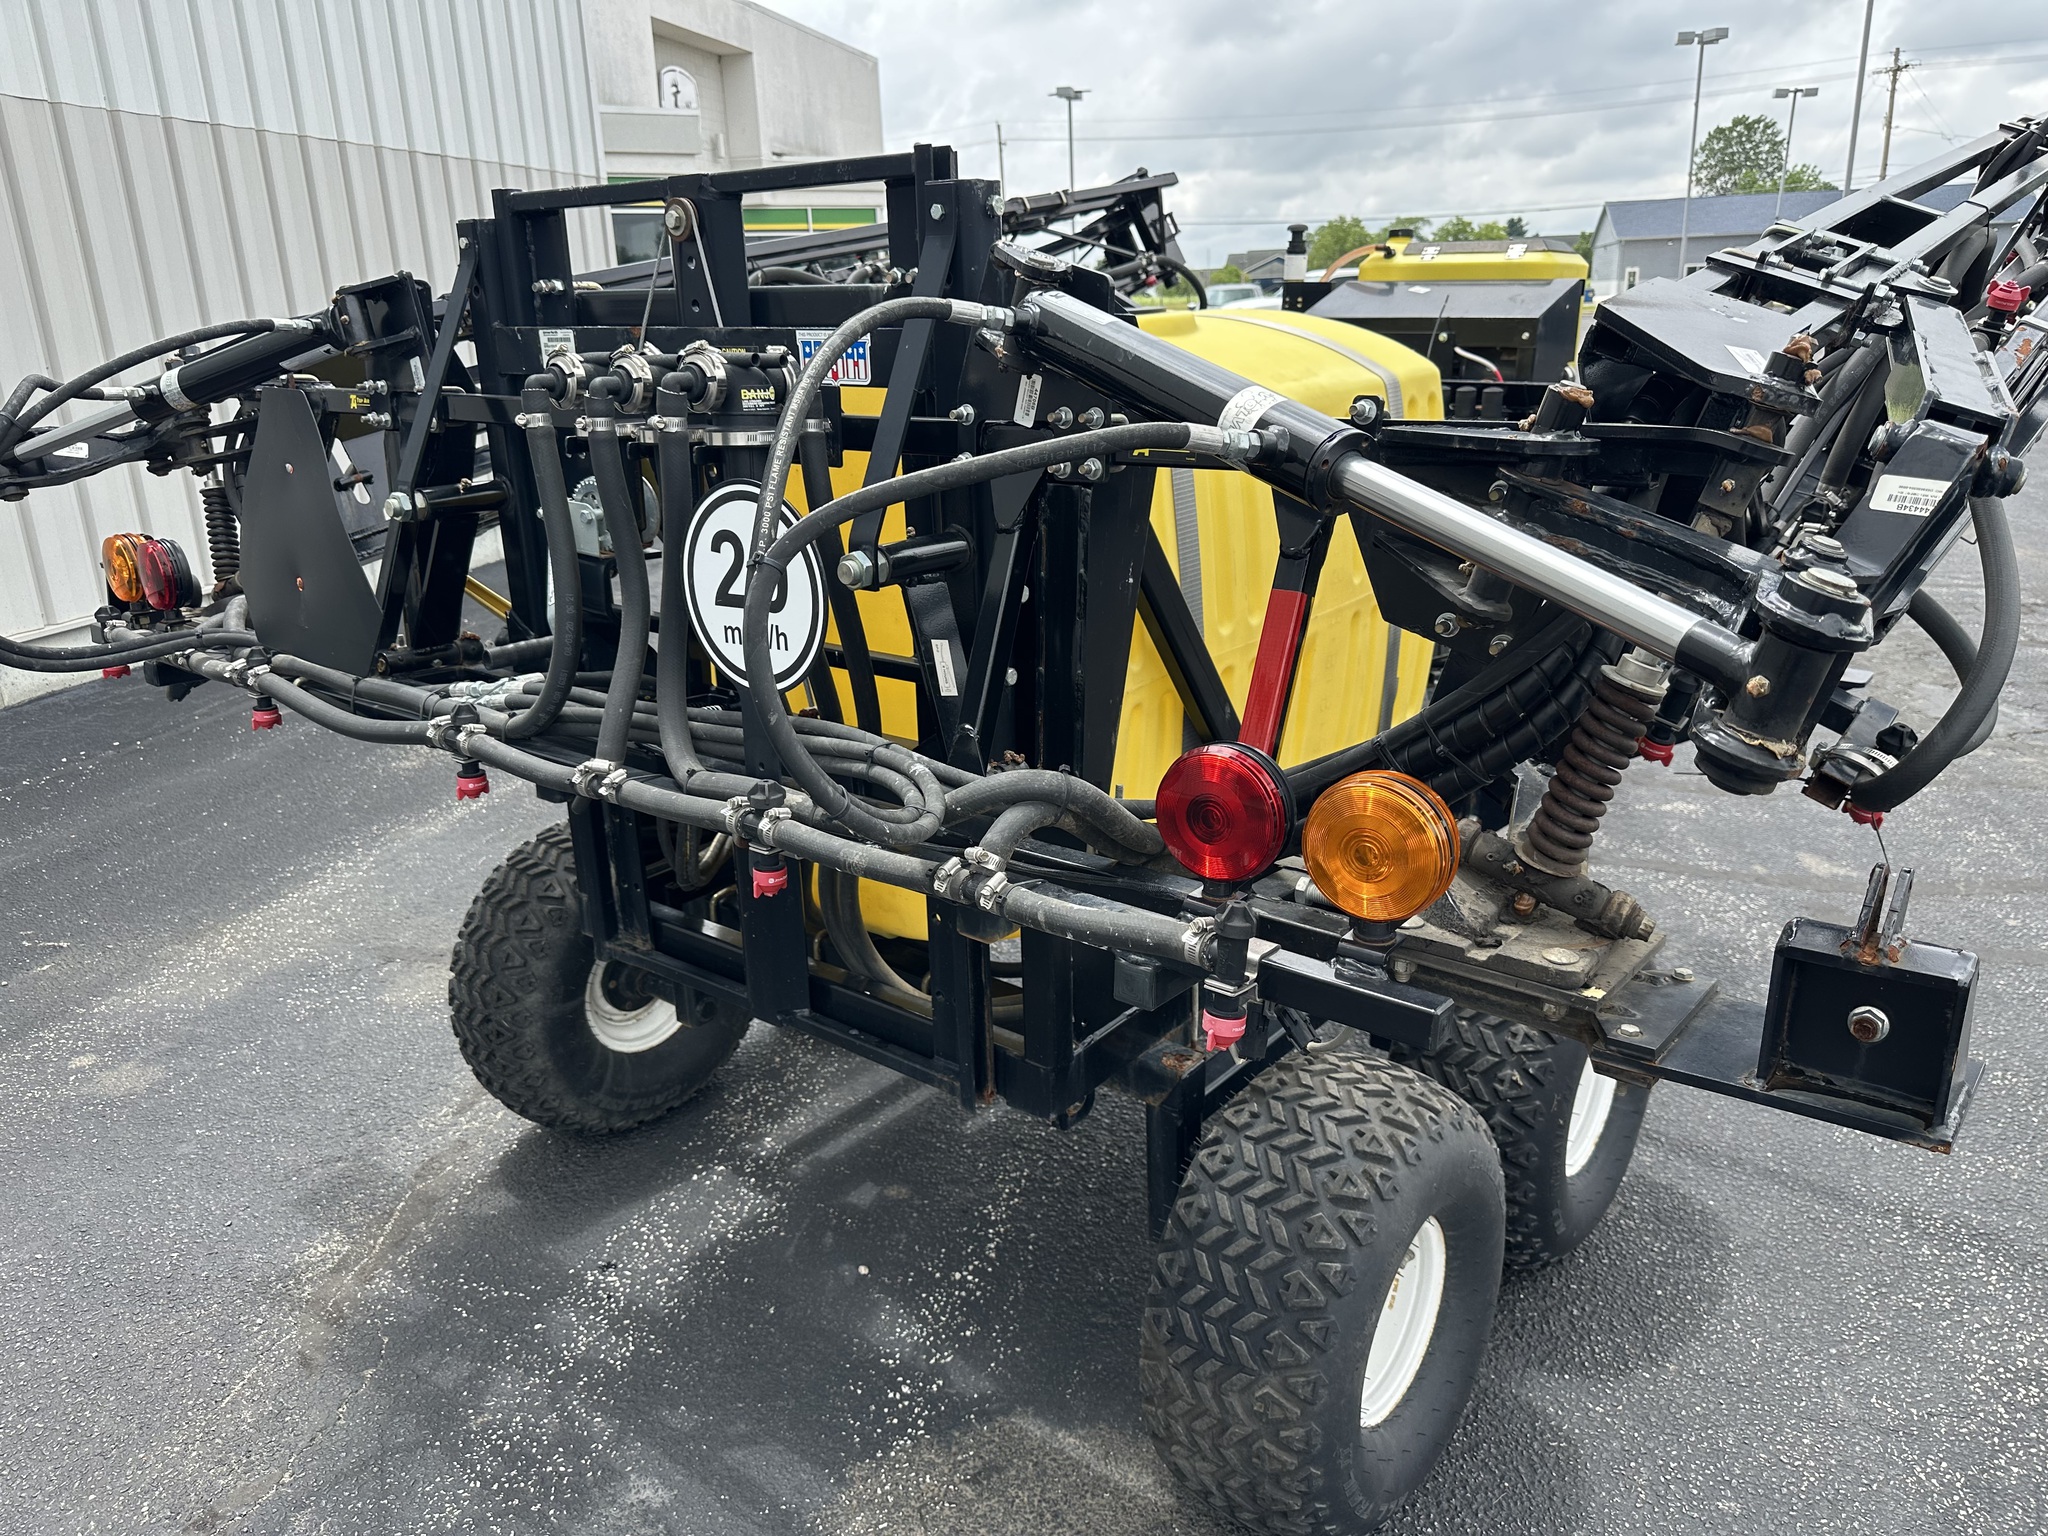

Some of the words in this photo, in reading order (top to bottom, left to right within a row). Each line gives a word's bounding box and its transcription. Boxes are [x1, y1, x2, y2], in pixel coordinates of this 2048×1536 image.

[802, 377, 813, 390] NO.
[792, 389, 805, 409] MSHA
[777, 412, 796, 457] RESISTANT
[769, 458, 781, 490] FLAME
[765, 490, 775, 508] PSI
[761, 511, 771, 534] 3000
[724, 624, 789, 651] m/h
